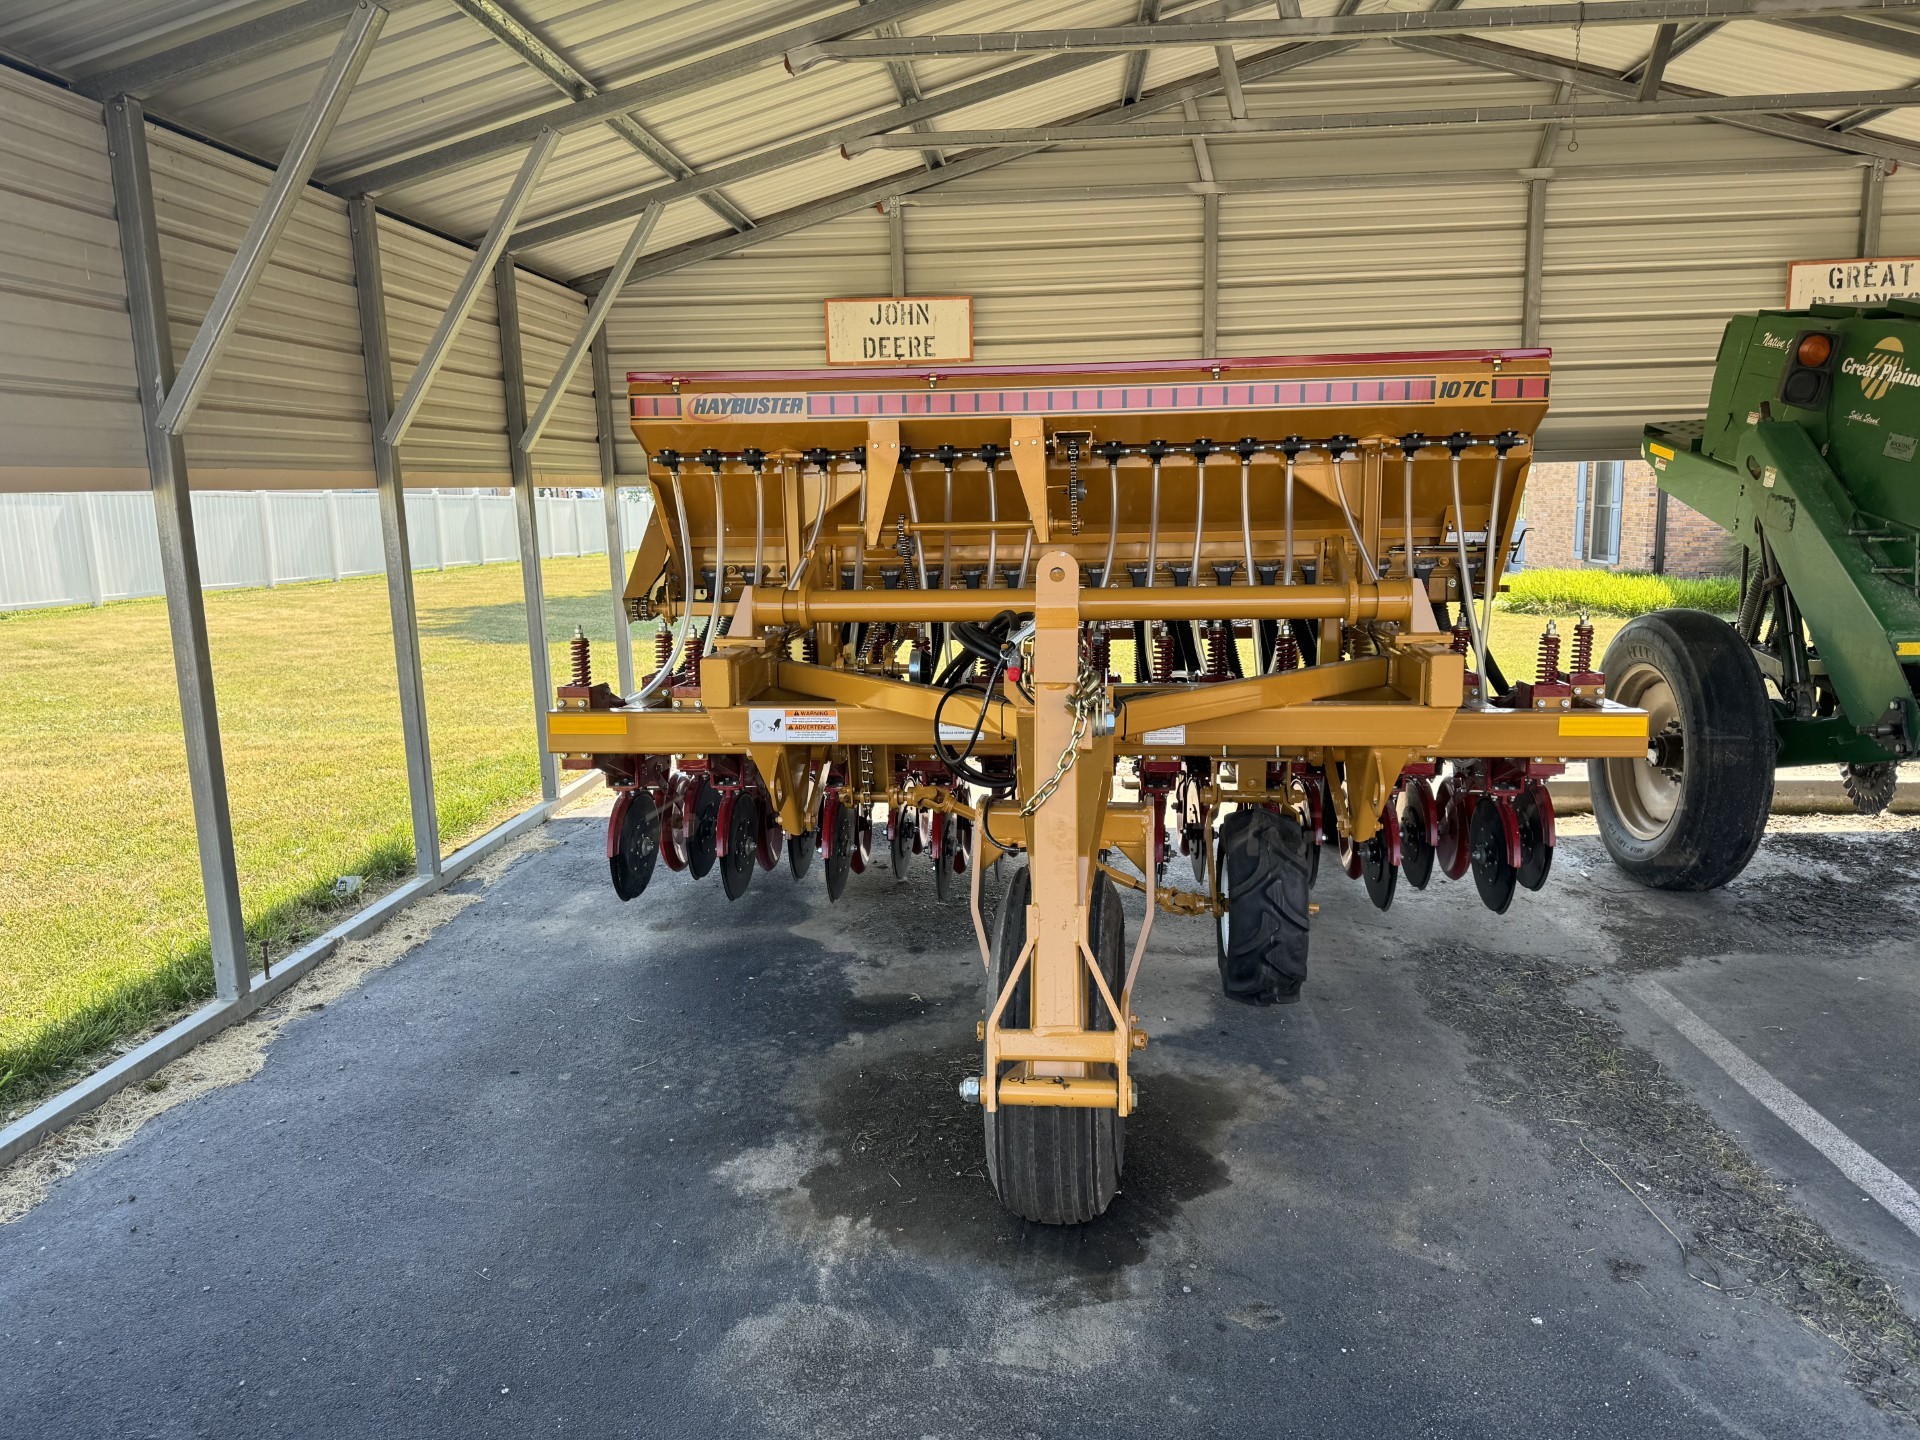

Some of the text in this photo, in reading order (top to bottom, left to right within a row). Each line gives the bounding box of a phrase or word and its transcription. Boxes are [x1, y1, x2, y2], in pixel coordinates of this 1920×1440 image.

[1828, 262, 1915, 289] GREAT
[869, 303, 930, 325] JOHN
[862, 335, 937, 358] DEERE
[1762, 332, 1786, 348] Native
[1841, 357, 1920, 388] Great Plains
[1438, 380, 1490, 399] 107C
[693, 397, 804, 415] HAYBUSTER
